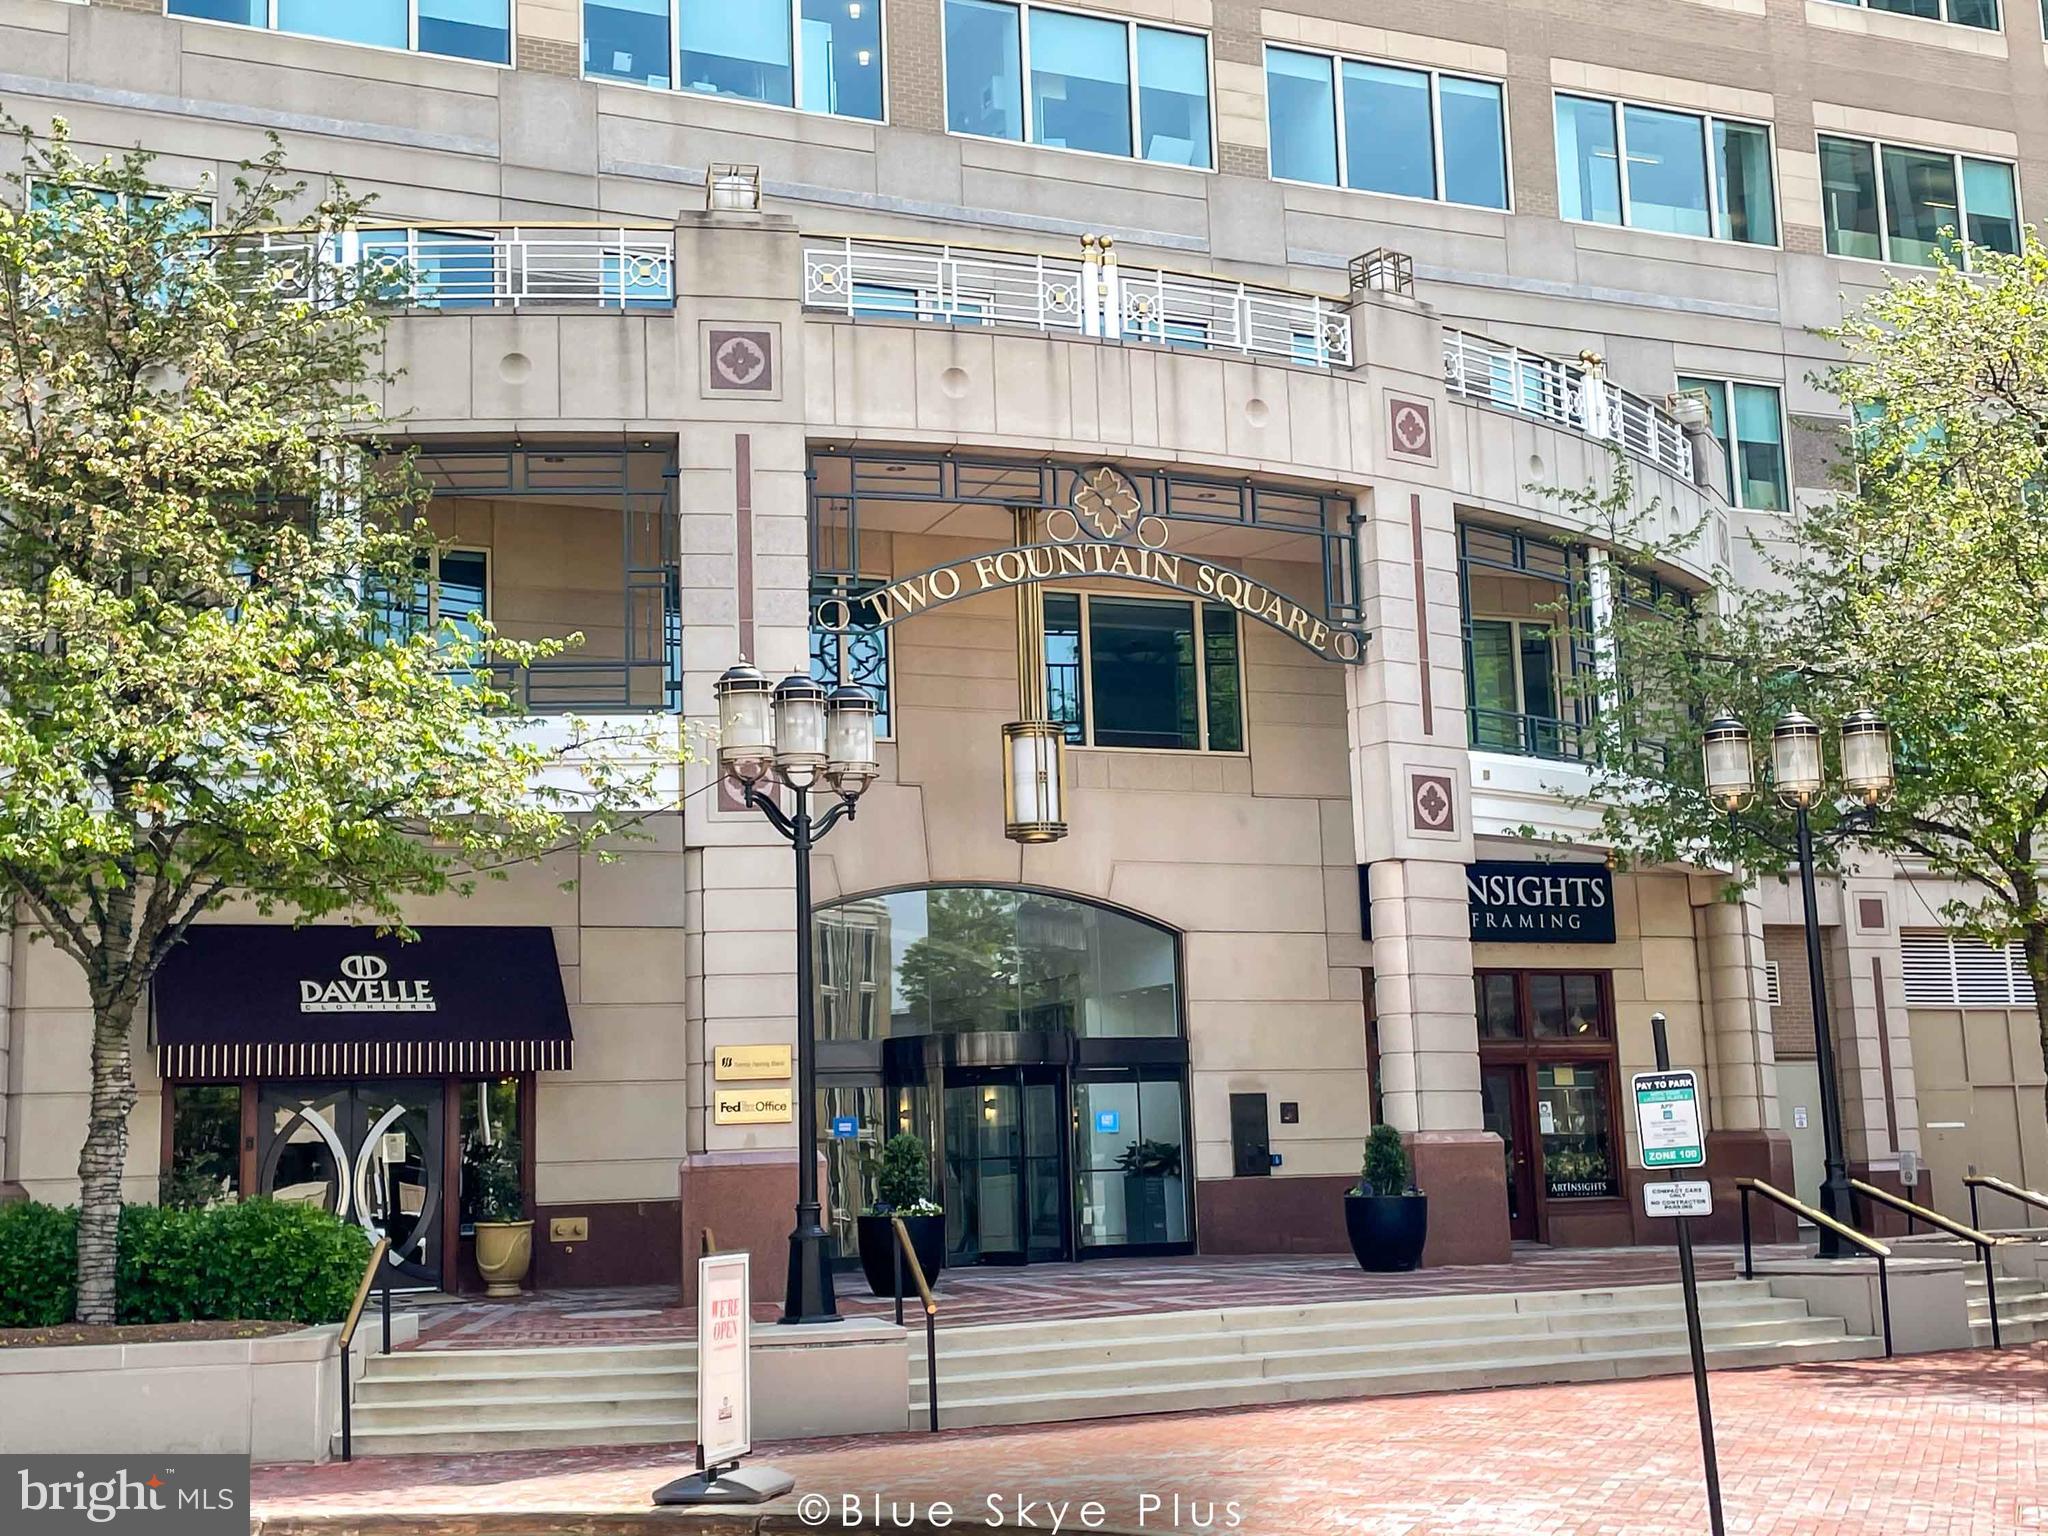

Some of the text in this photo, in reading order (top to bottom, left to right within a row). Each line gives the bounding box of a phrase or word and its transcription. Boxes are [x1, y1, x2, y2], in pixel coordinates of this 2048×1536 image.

[862, 543, 1330, 651] TWO FOUNTAIN SQUARE
[1471, 912, 1581, 929] FRAMING
[300, 980, 434, 1003] DAVELLE
[305, 1003, 432, 1011] CLOTHIERS
[1636, 1082, 1651, 1090] PAY
[1668, 1079, 1692, 1087] PARK
[755, 1100, 787, 1112] Office
[1649, 1151, 1676, 1160] ZONE
[713, 1320, 737, 1340] OPEN
